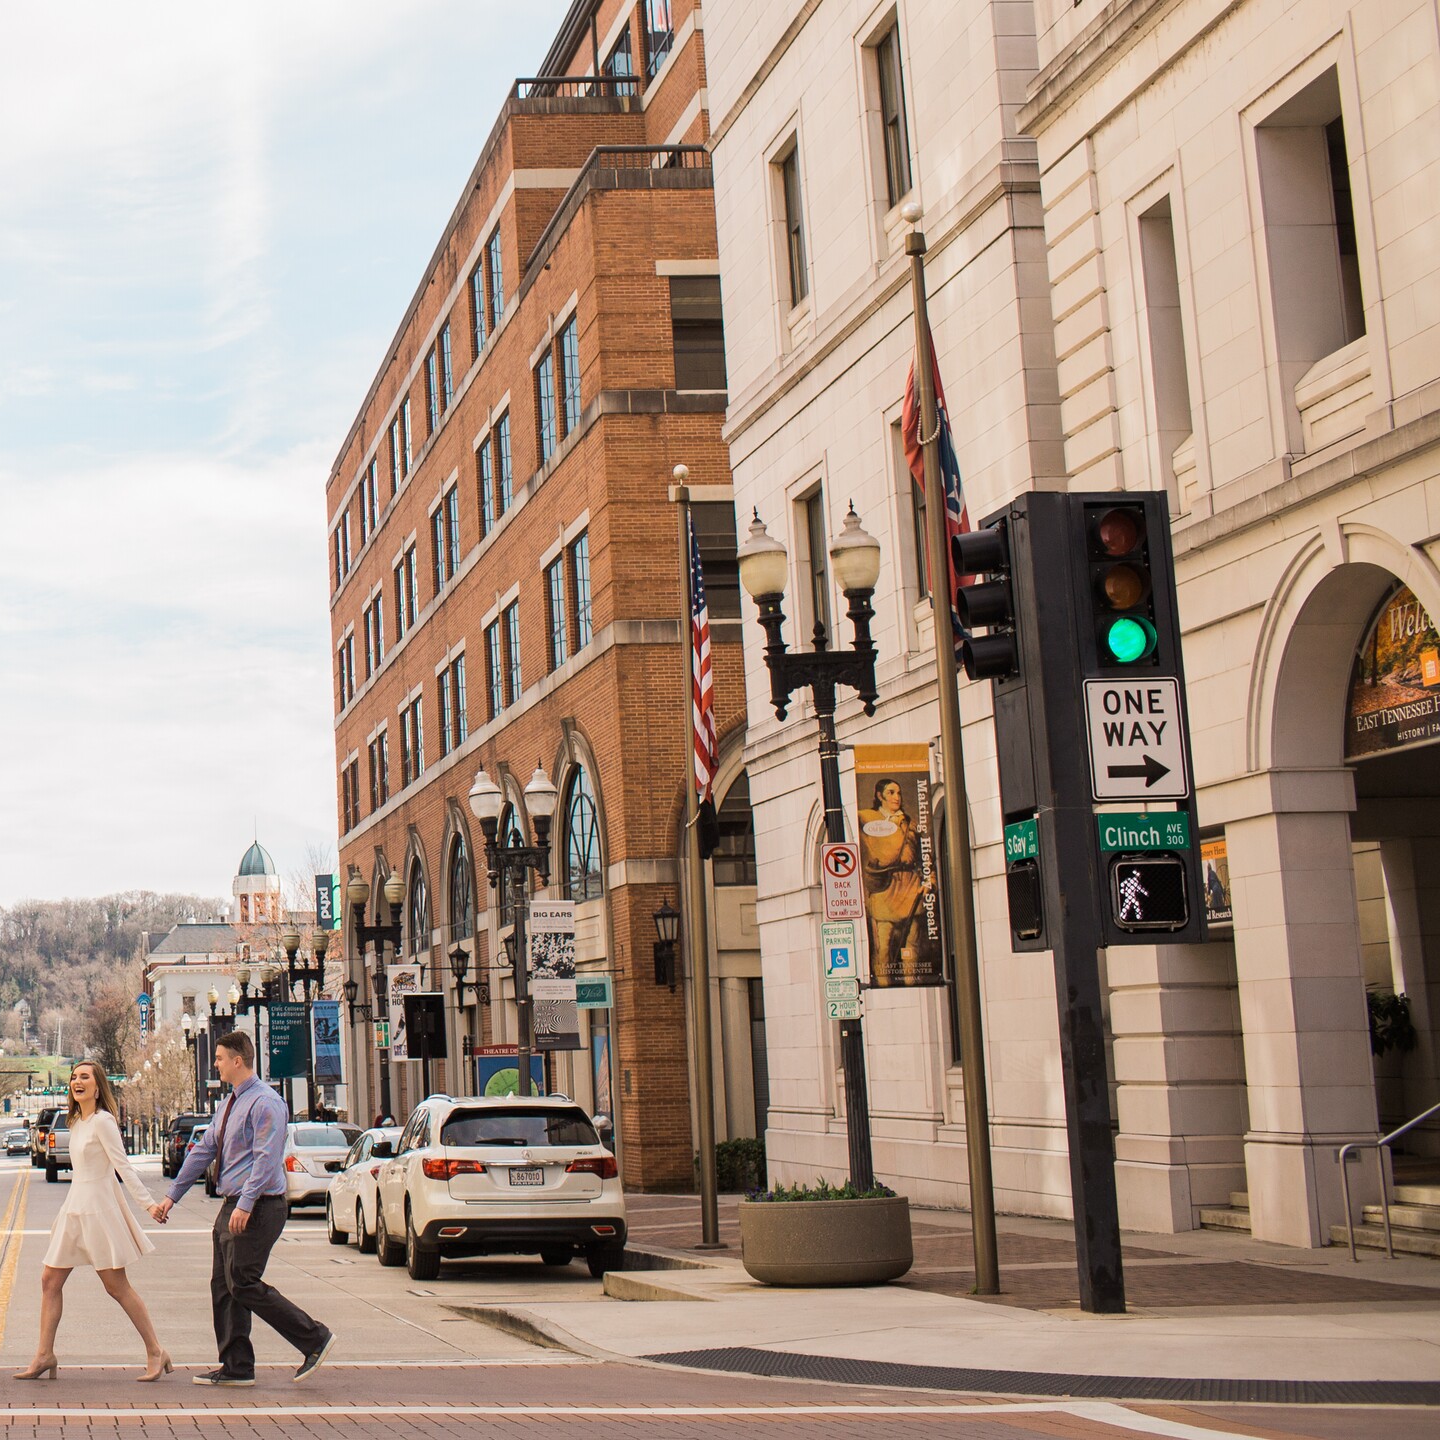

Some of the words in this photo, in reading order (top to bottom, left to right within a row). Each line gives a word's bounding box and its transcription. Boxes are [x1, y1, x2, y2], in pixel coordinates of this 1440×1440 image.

[1389, 600, 1435, 642] Welc
[1103, 689, 1164, 715] ONE
[1356, 714, 1378, 732] EAST
[1380, 700, 1433, 727] TENNESSEE
[1103, 721, 1167, 747] WAY
[1397, 727, 1425, 741] HISTORY
[916, 779, 929, 834] Making
[1007, 838, 1012, 855] S
[1012, 834, 1026, 857] Gay
[1028, 831, 1034, 841] ST
[1105, 826, 1160, 847] Clinch
[1166, 823, 1182, 833] AVE
[1166, 835, 1184, 845] 300
[920, 836, 933, 891] History
[318, 886, 332, 919] pyxl
[831, 899, 858, 907] CORNER
[839, 890, 848, 898] TO
[925, 893, 939, 940] Speak!
[1212, 908, 1232, 920] Research
[823, 926, 853, 935] RESERVED
[826, 937, 852, 945] PARKING
[830, 1003, 838, 1016] 2
[839, 1009, 857, 1017] LIMIT
